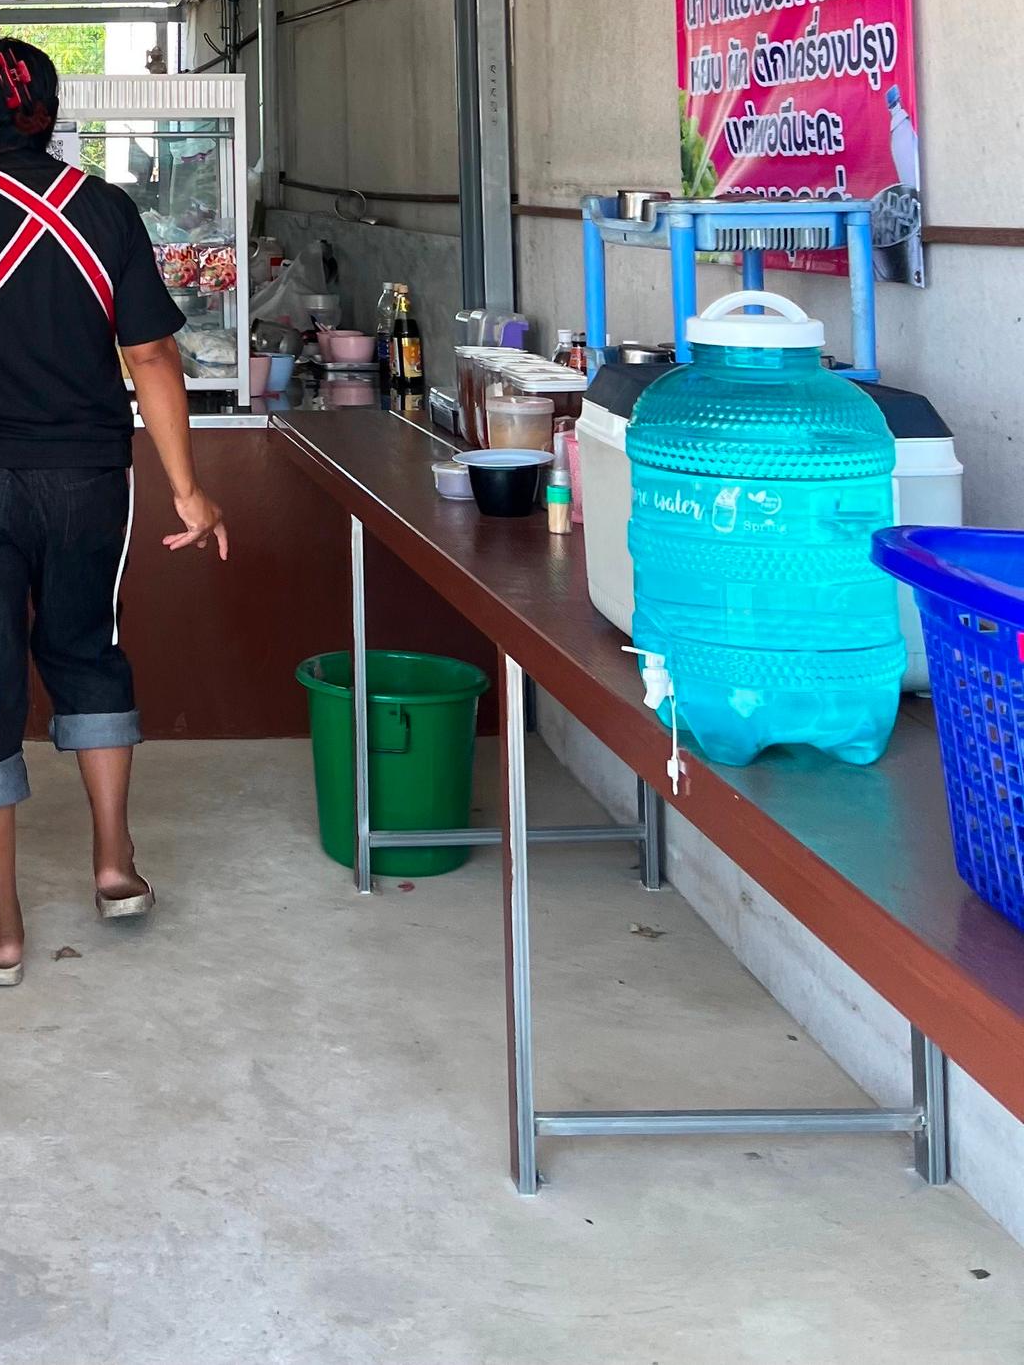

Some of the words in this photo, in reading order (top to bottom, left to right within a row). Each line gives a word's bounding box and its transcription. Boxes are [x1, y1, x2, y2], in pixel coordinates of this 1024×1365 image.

[691, 48, 722, 93] หยิบ
[753, 10, 895, 87] ตักเครื่องปรุง
[726, 104, 843, 154] แต่พอดีนะคะ
[653, 488, 705, 521] water
